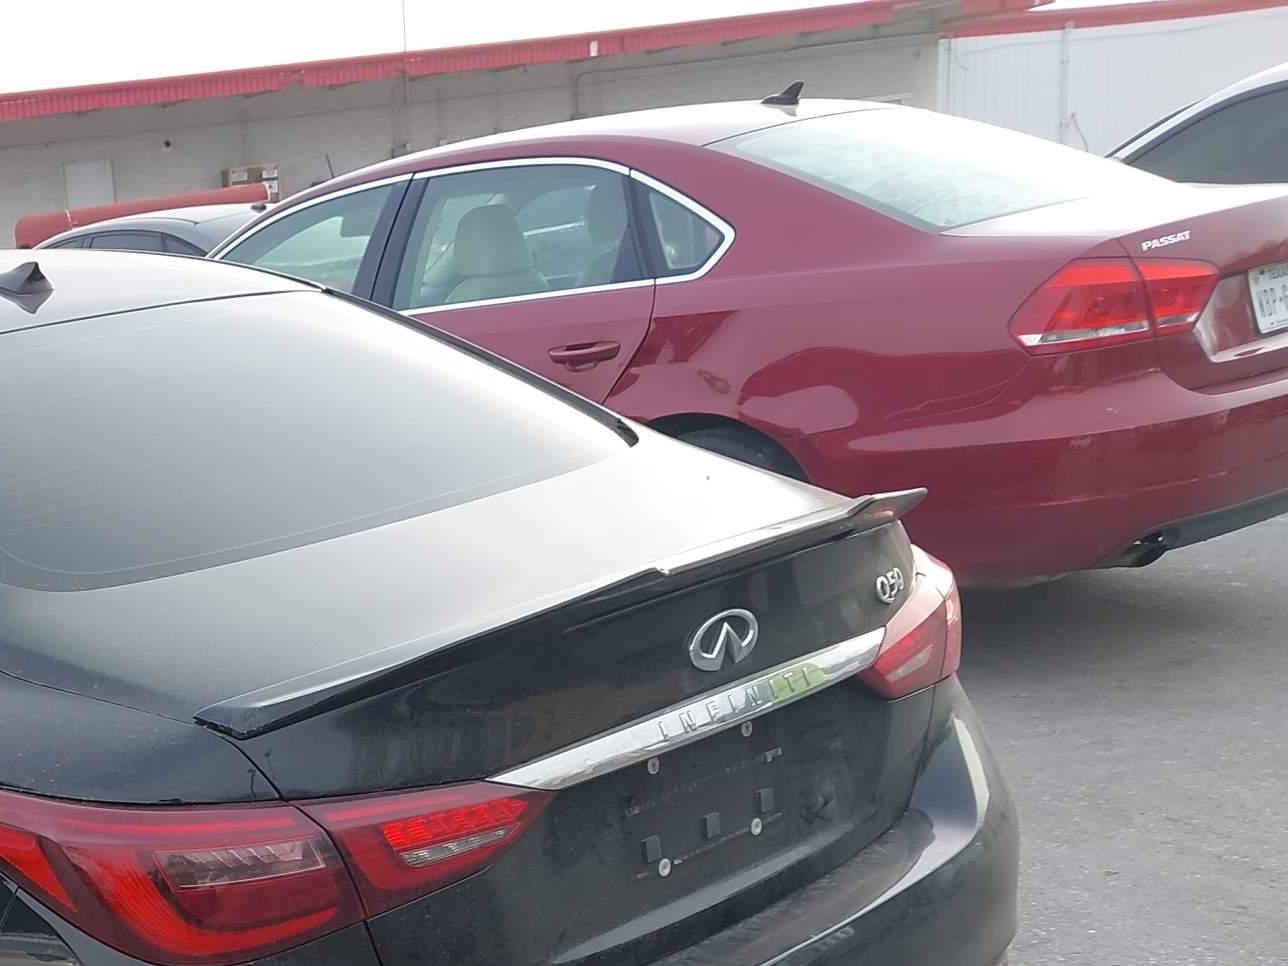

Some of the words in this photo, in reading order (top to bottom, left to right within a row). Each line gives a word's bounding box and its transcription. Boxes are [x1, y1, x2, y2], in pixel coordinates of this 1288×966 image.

[1141, 230, 1192, 252] PASSAT
[875, 566, 905, 604] Q50
[657, 666, 811, 742] INFINITI
